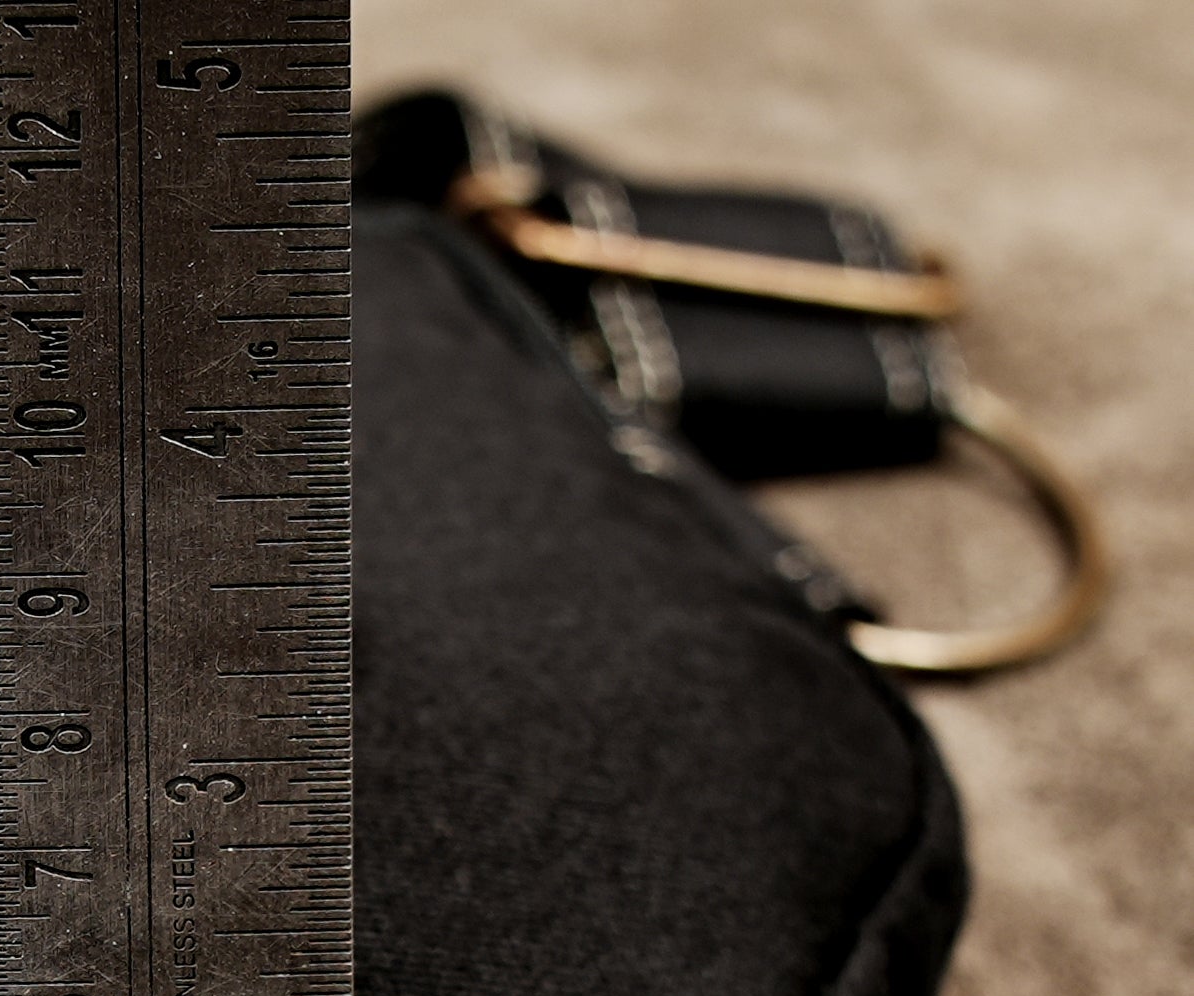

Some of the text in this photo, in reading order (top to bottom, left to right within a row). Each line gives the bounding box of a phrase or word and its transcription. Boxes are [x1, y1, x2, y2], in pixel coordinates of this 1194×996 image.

[4, 15, 80, 41] 1
[156, 57, 243, 92] 5
[7, 110, 82, 183] 12
[10, 268, 84, 333] 11
[248, 340, 279, 382] 16
[14, 401, 87, 469] 10
[159, 421, 244, 459] 4
[17, 587, 90, 618] 9
[20, 723, 93, 755] 8
[165, 772, 246, 805] 3
[24, 859, 94, 889] 7
[171, 829, 196, 910] STEEL
